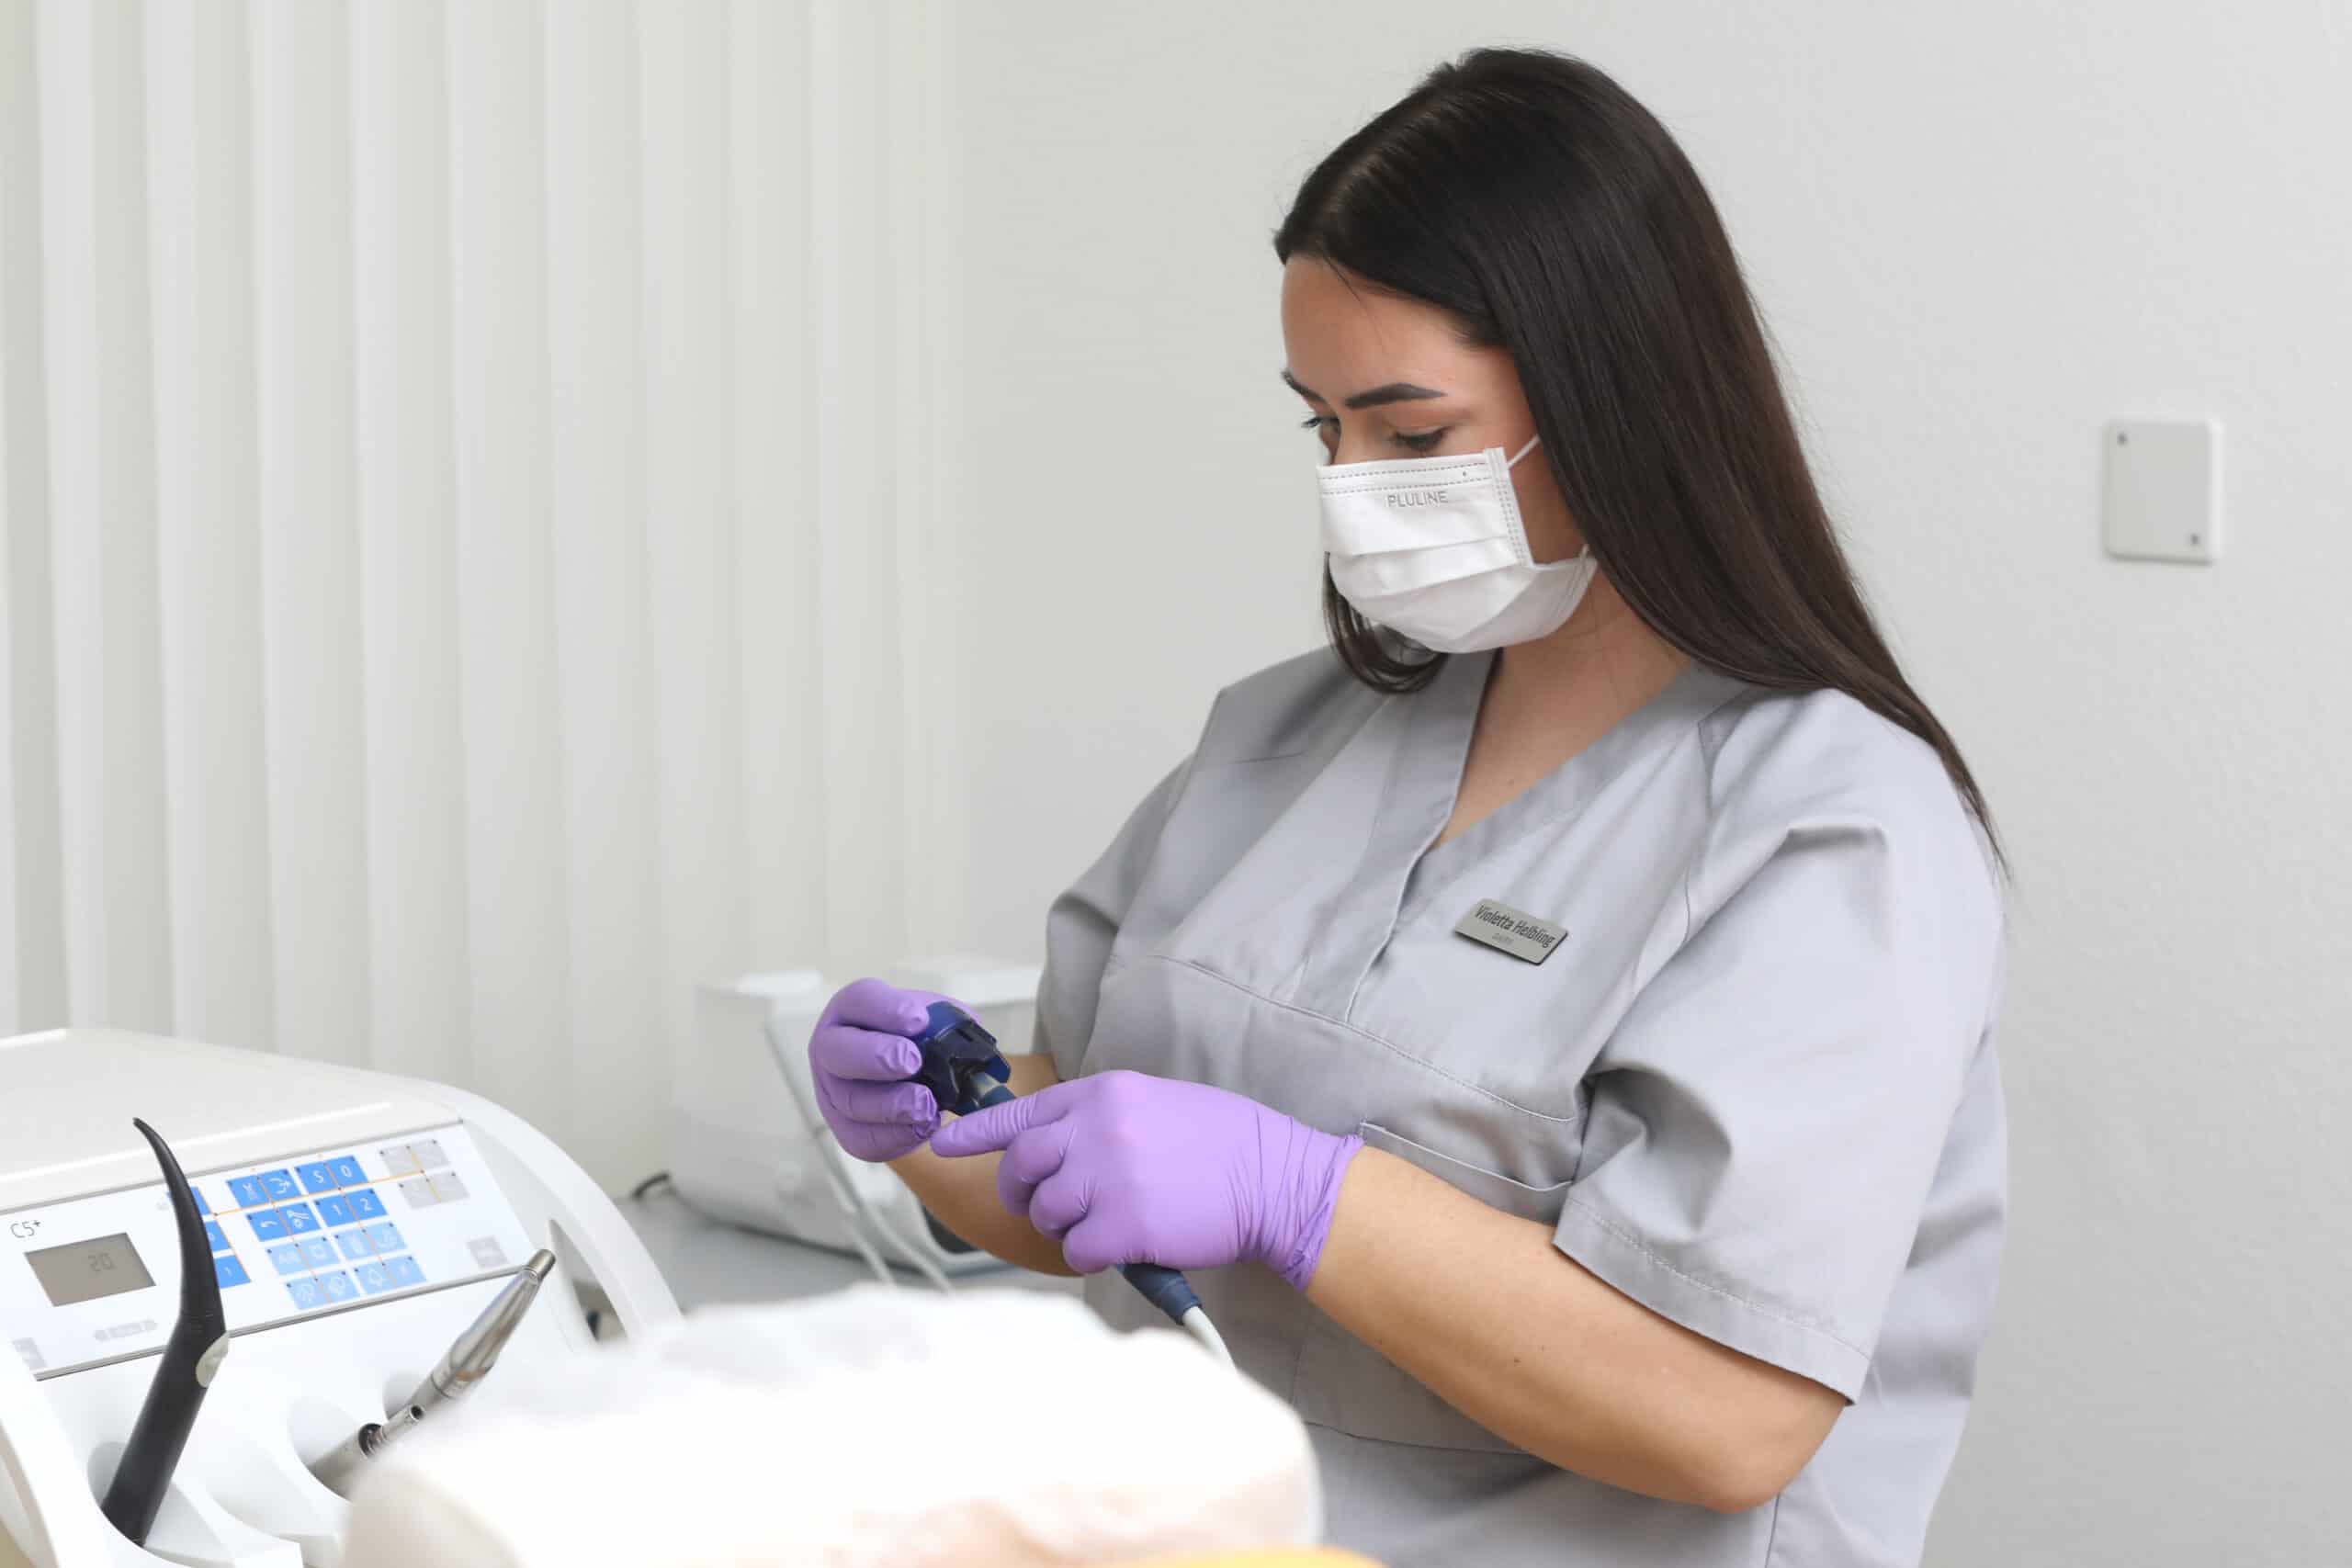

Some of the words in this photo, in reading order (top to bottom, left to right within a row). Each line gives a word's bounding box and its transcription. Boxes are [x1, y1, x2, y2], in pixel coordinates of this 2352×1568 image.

[1386, 491, 1449, 507] PLULINE
[1475, 904, 1514, 931] Violetta
[1512, 919, 1556, 949] Helbling
[360, 1197, 373, 1212] 2
